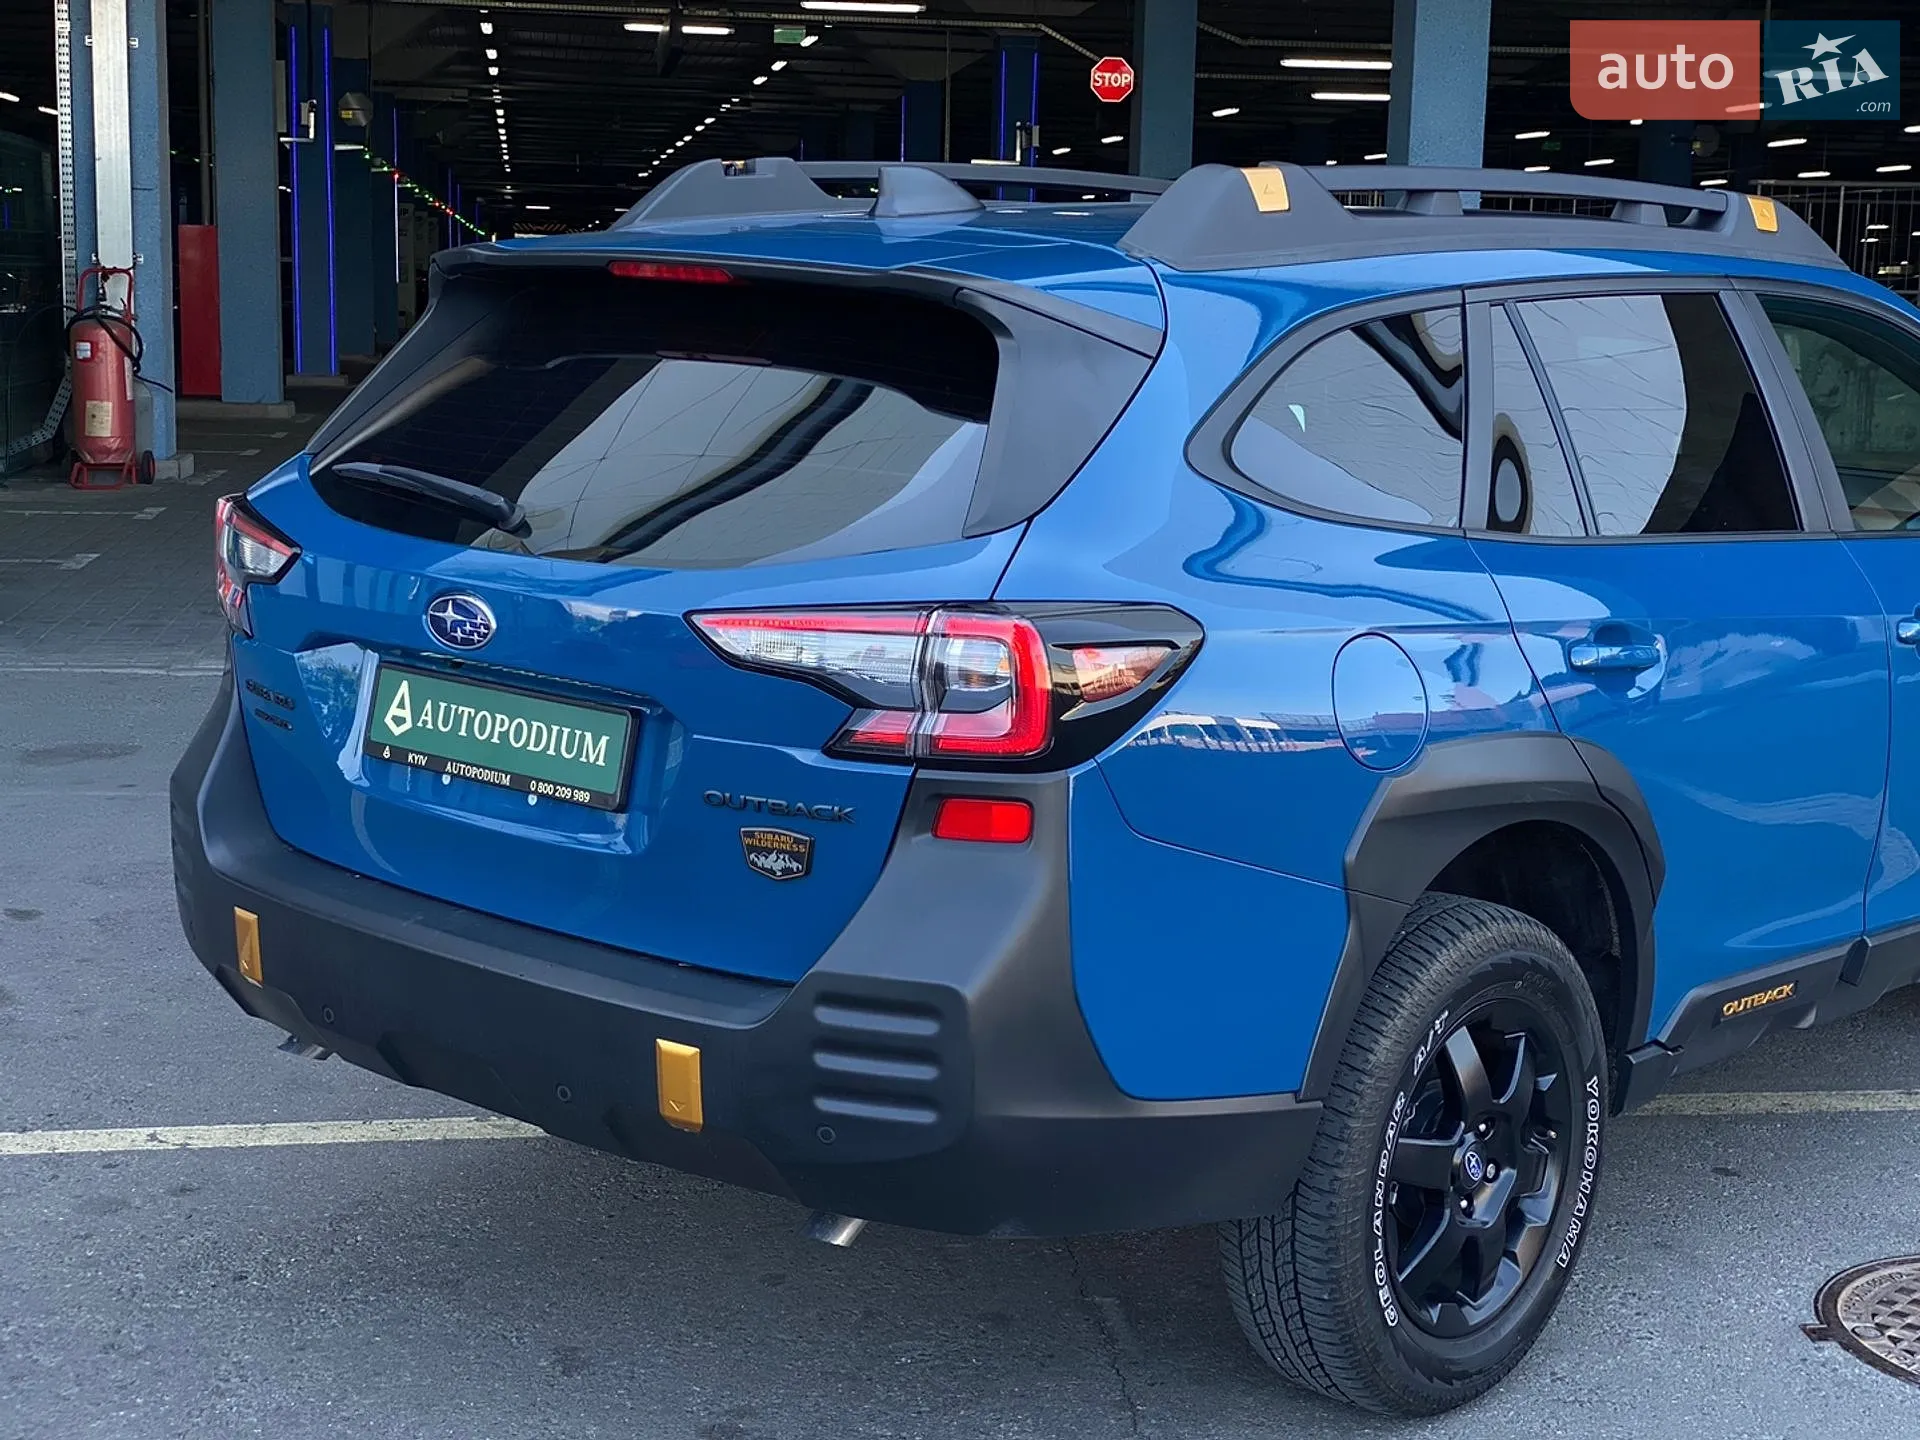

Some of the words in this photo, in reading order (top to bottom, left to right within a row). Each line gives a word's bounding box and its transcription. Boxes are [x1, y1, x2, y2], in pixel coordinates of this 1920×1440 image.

[1093, 72, 1131, 88] STOP
[417, 700, 610, 766] AUTOPODIUM
[408, 752, 428, 767] KYIV
[445, 761, 511, 786] AUTOPODIUM
[529, 779, 537, 792] 0
[537, 782, 555, 796] 800
[555, 786, 573, 799] 209
[573, 790, 592, 804] 989
[703, 790, 856, 824] OUTBACK
[744, 837, 806, 852] WILDERNESS
[754, 832, 794, 843] SUBARU
[1722, 983, 1794, 1016] OUTBACK
[1374, 1091, 1405, 1328] GEOLANDAR
[1413, 1009, 1449, 1077] A/T
[1555, 1075, 1601, 1269] YOKOHAMA
